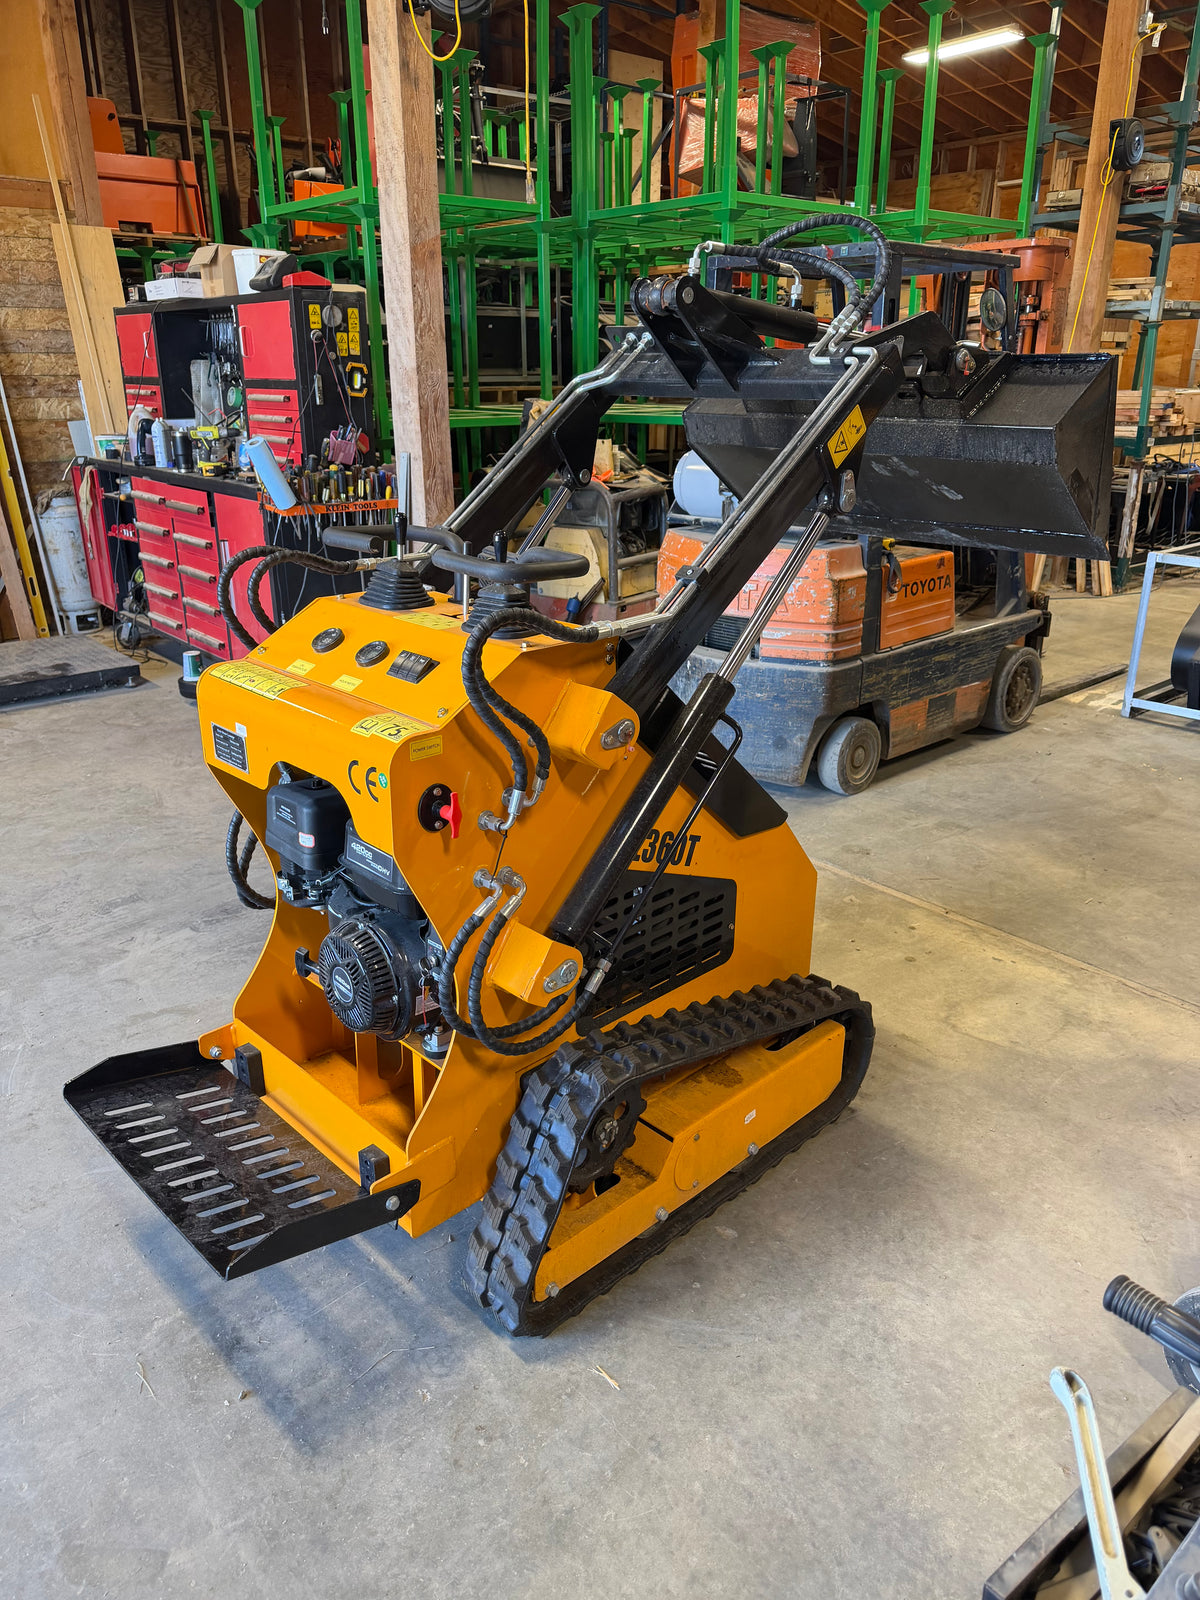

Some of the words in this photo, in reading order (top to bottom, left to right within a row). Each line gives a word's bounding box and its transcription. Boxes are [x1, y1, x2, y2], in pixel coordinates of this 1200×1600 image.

[325, 504, 350, 512] KLEIN
[353, 502, 377, 510] TOOLS
[902, 574, 951, 598] TOYOTA
[380, 723, 408, 737] 75
[631, 829, 701, 867] 360T
